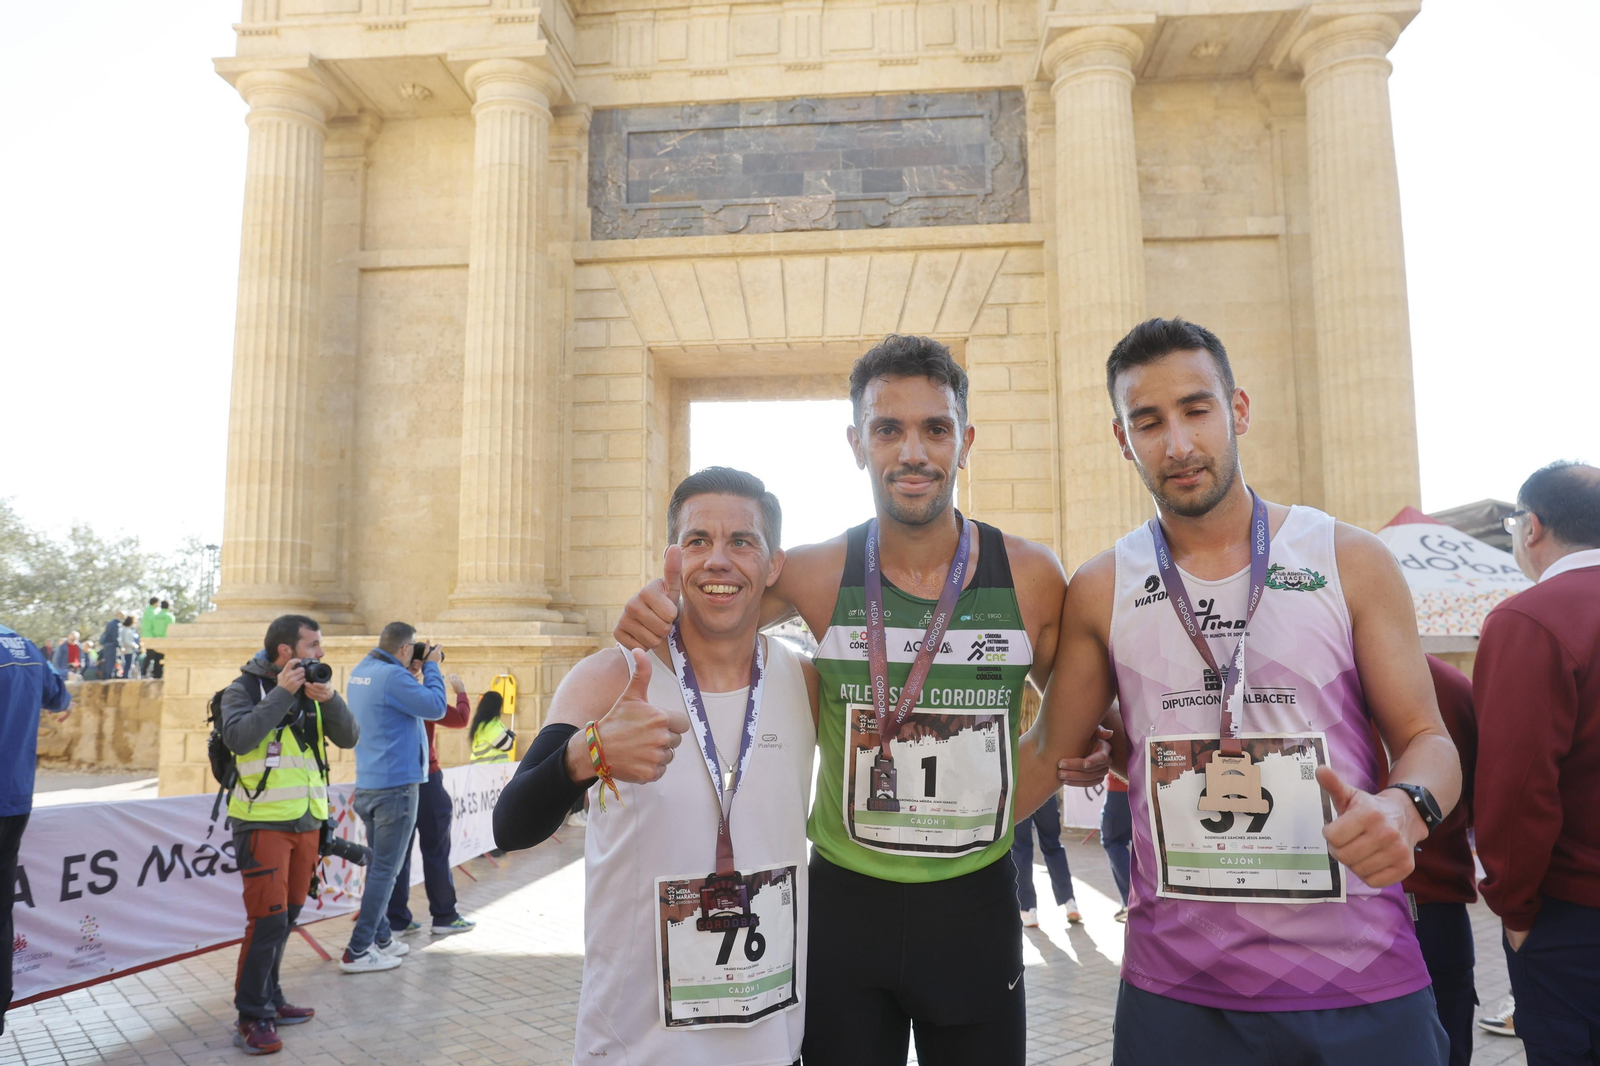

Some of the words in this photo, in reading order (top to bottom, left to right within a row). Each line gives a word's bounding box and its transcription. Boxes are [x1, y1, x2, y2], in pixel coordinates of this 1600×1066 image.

[952, 562, 964, 585] MEDIA
[1249, 584, 1260, 612] MEDIA
[870, 600, 879, 626] MEDIA
[1177, 595, 1198, 637] CÓRDOBA
[925, 612, 946, 652] CÓRDOBA
[985, 653, 1007, 662] CAC
[874, 674, 885, 719] CÓRDOBA
[930, 685, 1012, 707] CORDOBÉS
[1162, 693, 1222, 710] DIPUTACIÓN
[896, 697, 913, 725] MEDIA
[921, 755, 937, 798] 1
[910, 817, 939, 826] CAJÓN
[1219, 857, 1254, 865] CAJÓN
[60, 850, 119, 902] ES
[711, 924, 767, 966] 76
[728, 985, 755, 994] CAJÓN
